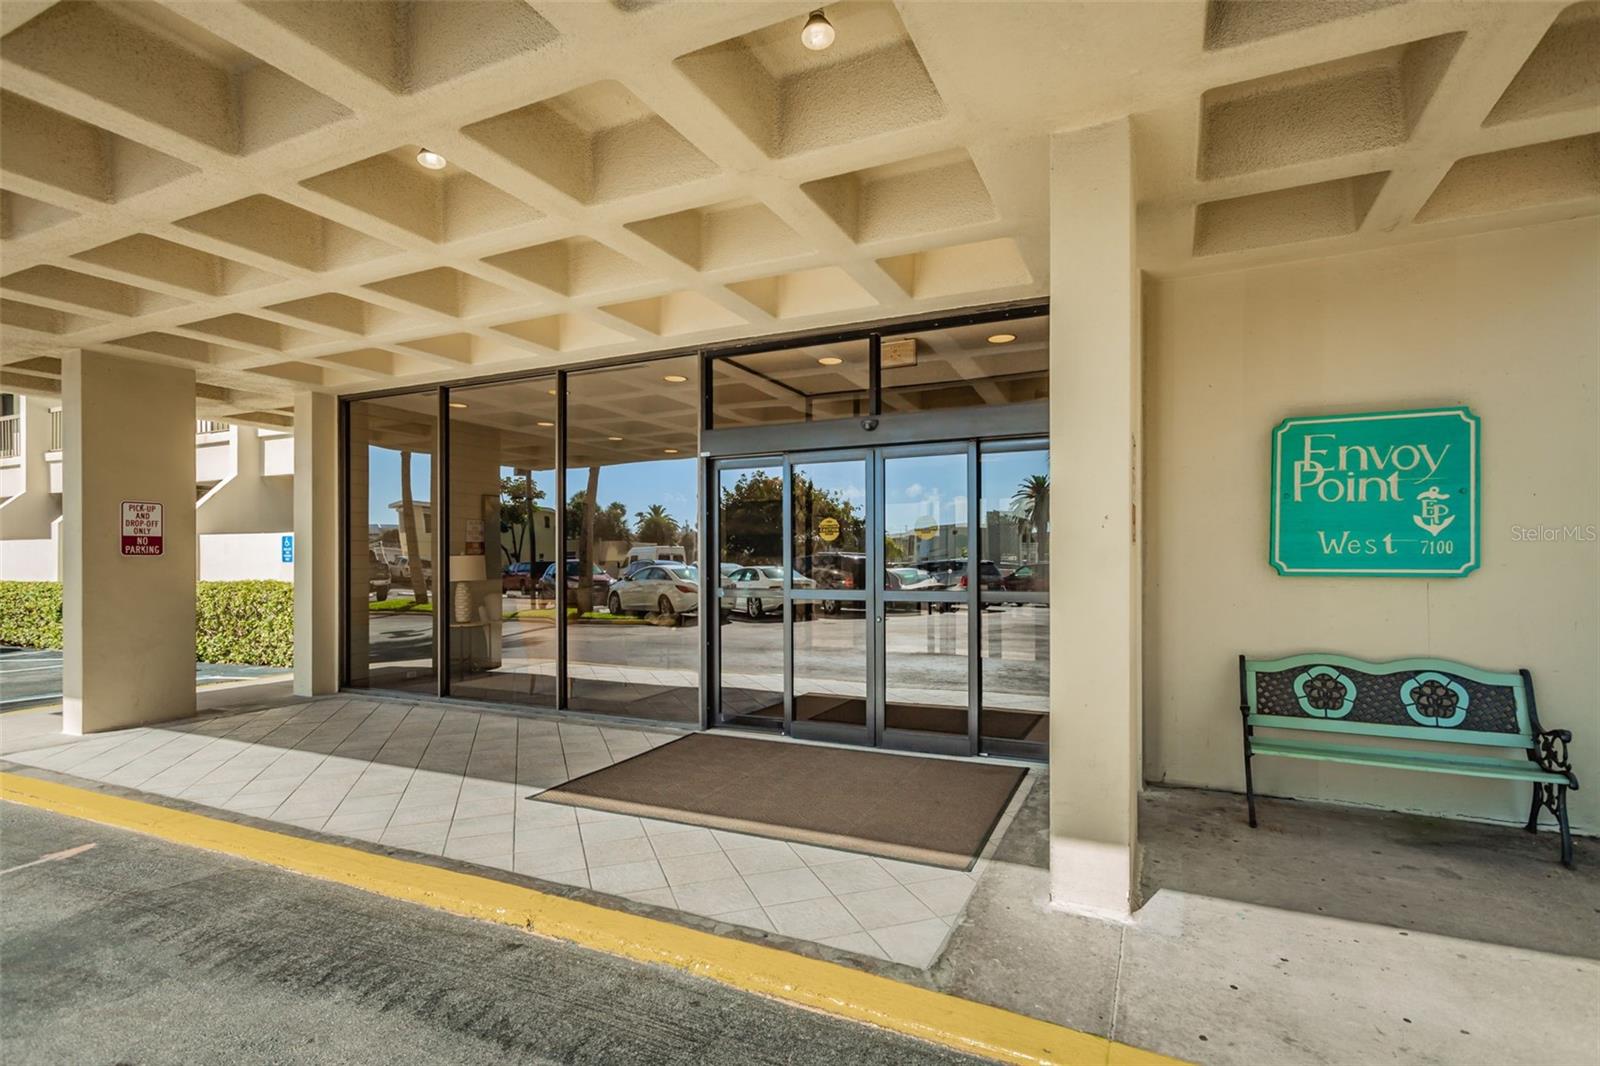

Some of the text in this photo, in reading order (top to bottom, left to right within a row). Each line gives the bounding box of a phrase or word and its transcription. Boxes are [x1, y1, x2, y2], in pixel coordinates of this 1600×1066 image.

[1303, 433, 1451, 484] Envoy
[1293, 459, 1404, 503] Point
[128, 504, 156, 512] PICK-UP
[125, 519, 160, 527] DROP-OFF
[136, 537, 148, 545] NO
[1317, 530, 1454, 555] West 7100
[125, 545, 160, 554] PARKING
